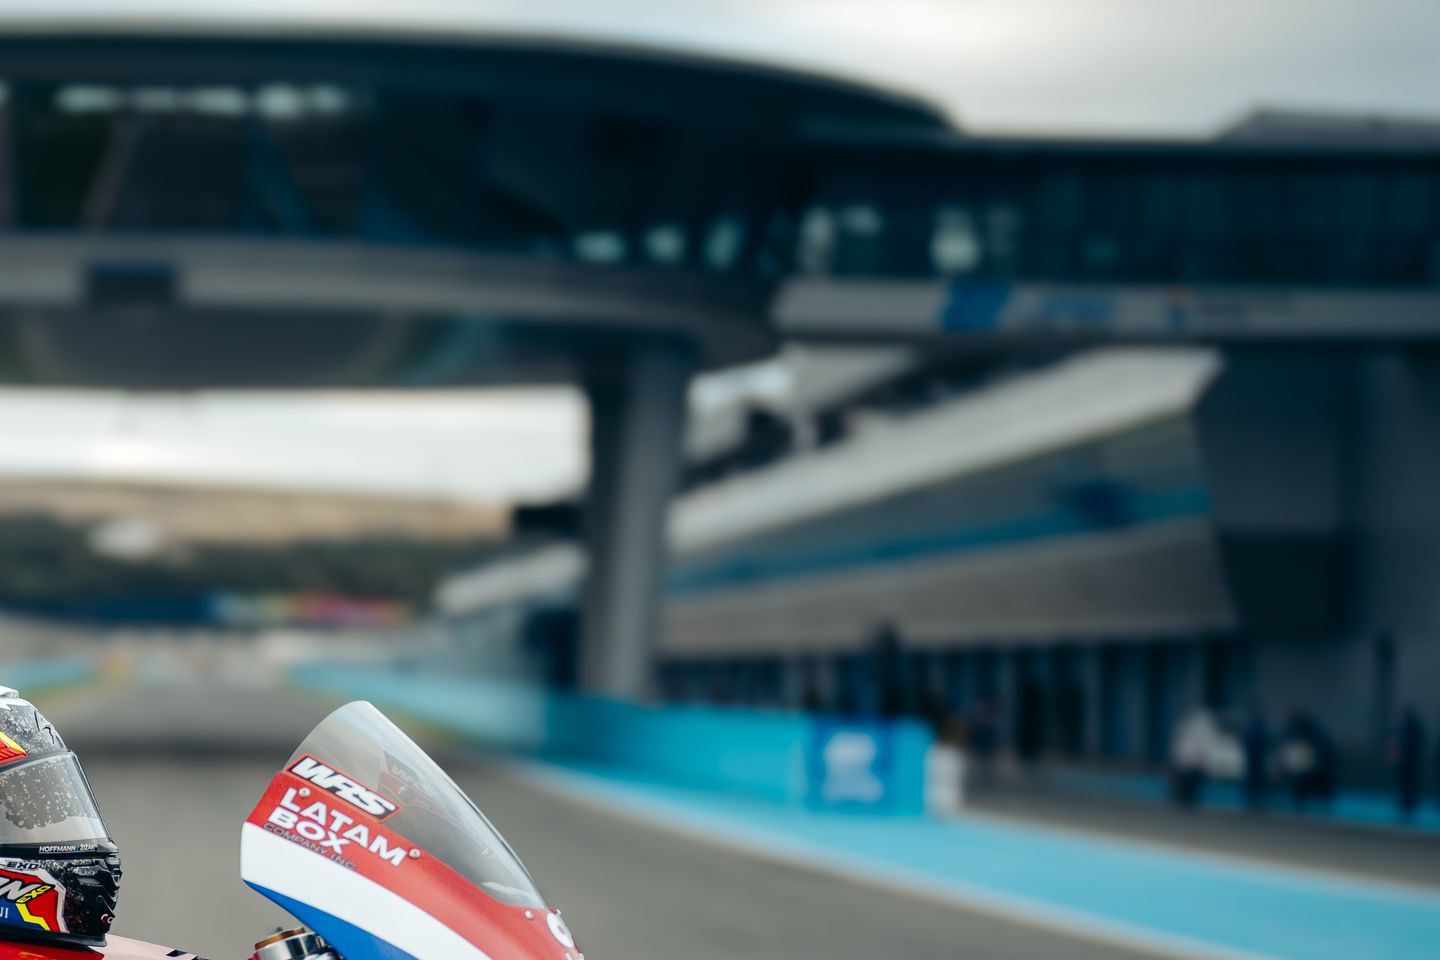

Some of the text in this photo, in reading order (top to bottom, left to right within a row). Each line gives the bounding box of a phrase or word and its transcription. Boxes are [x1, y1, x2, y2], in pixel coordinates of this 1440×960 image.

[291, 756, 398, 816] WRS
[263, 822, 328, 856] COMPANY
[267, 806, 350, 855] BOX
[279, 787, 408, 867] LATAM
